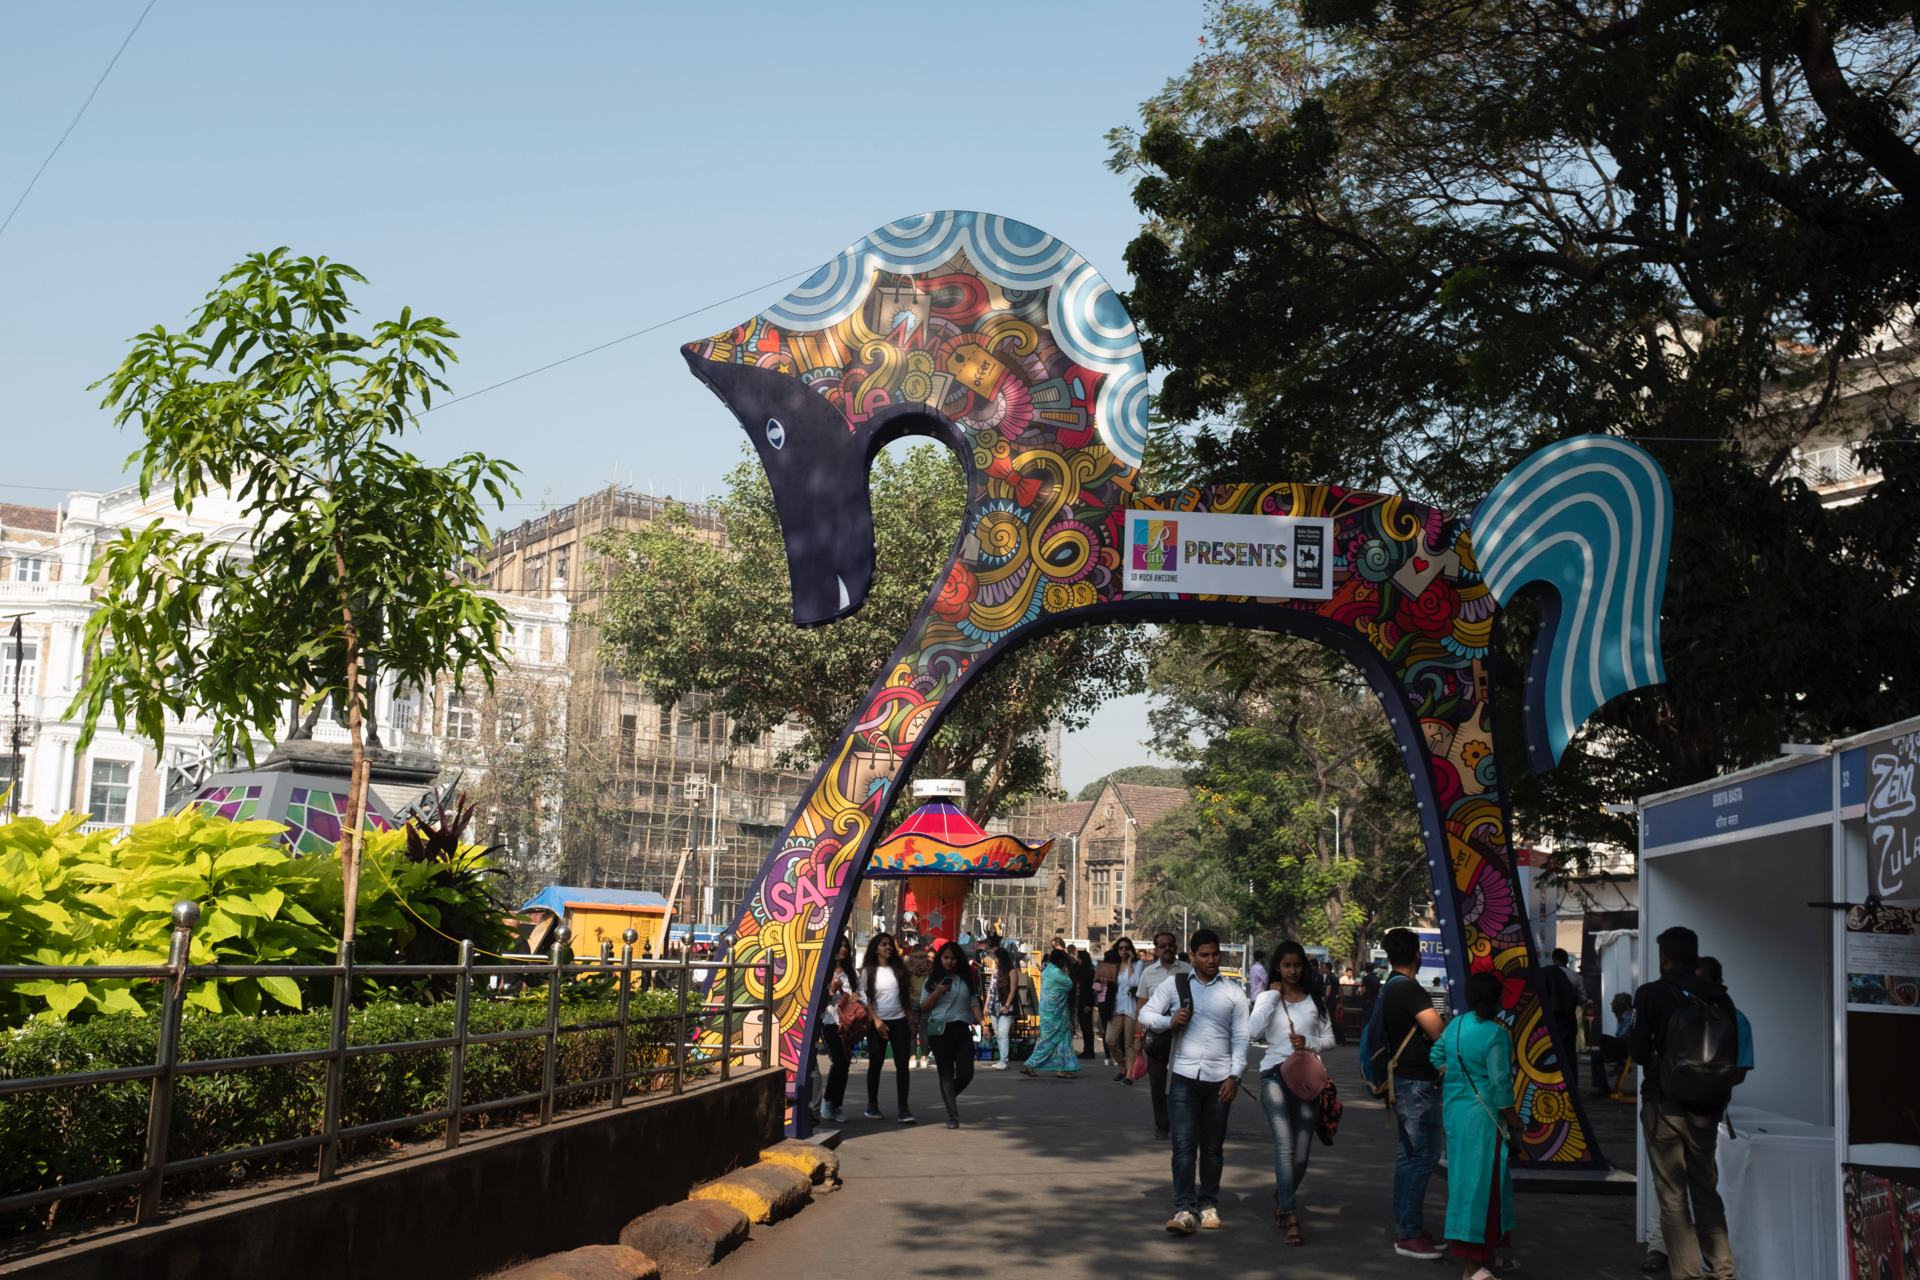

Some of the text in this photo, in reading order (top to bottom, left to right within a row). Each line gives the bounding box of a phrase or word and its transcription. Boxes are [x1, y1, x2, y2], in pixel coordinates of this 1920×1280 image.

[1142, 552, 1168, 566] City
[1184, 540, 1287, 568] PRESENTS
[1131, 573, 1178, 582] SO MUCH AWESOME
[1841, 770, 1850, 788] 32
[1713, 787, 1743, 808] BORIYA BASTA
[1452, 848, 1467, 873] ffer
[1419, 940, 1444, 954] RTE
